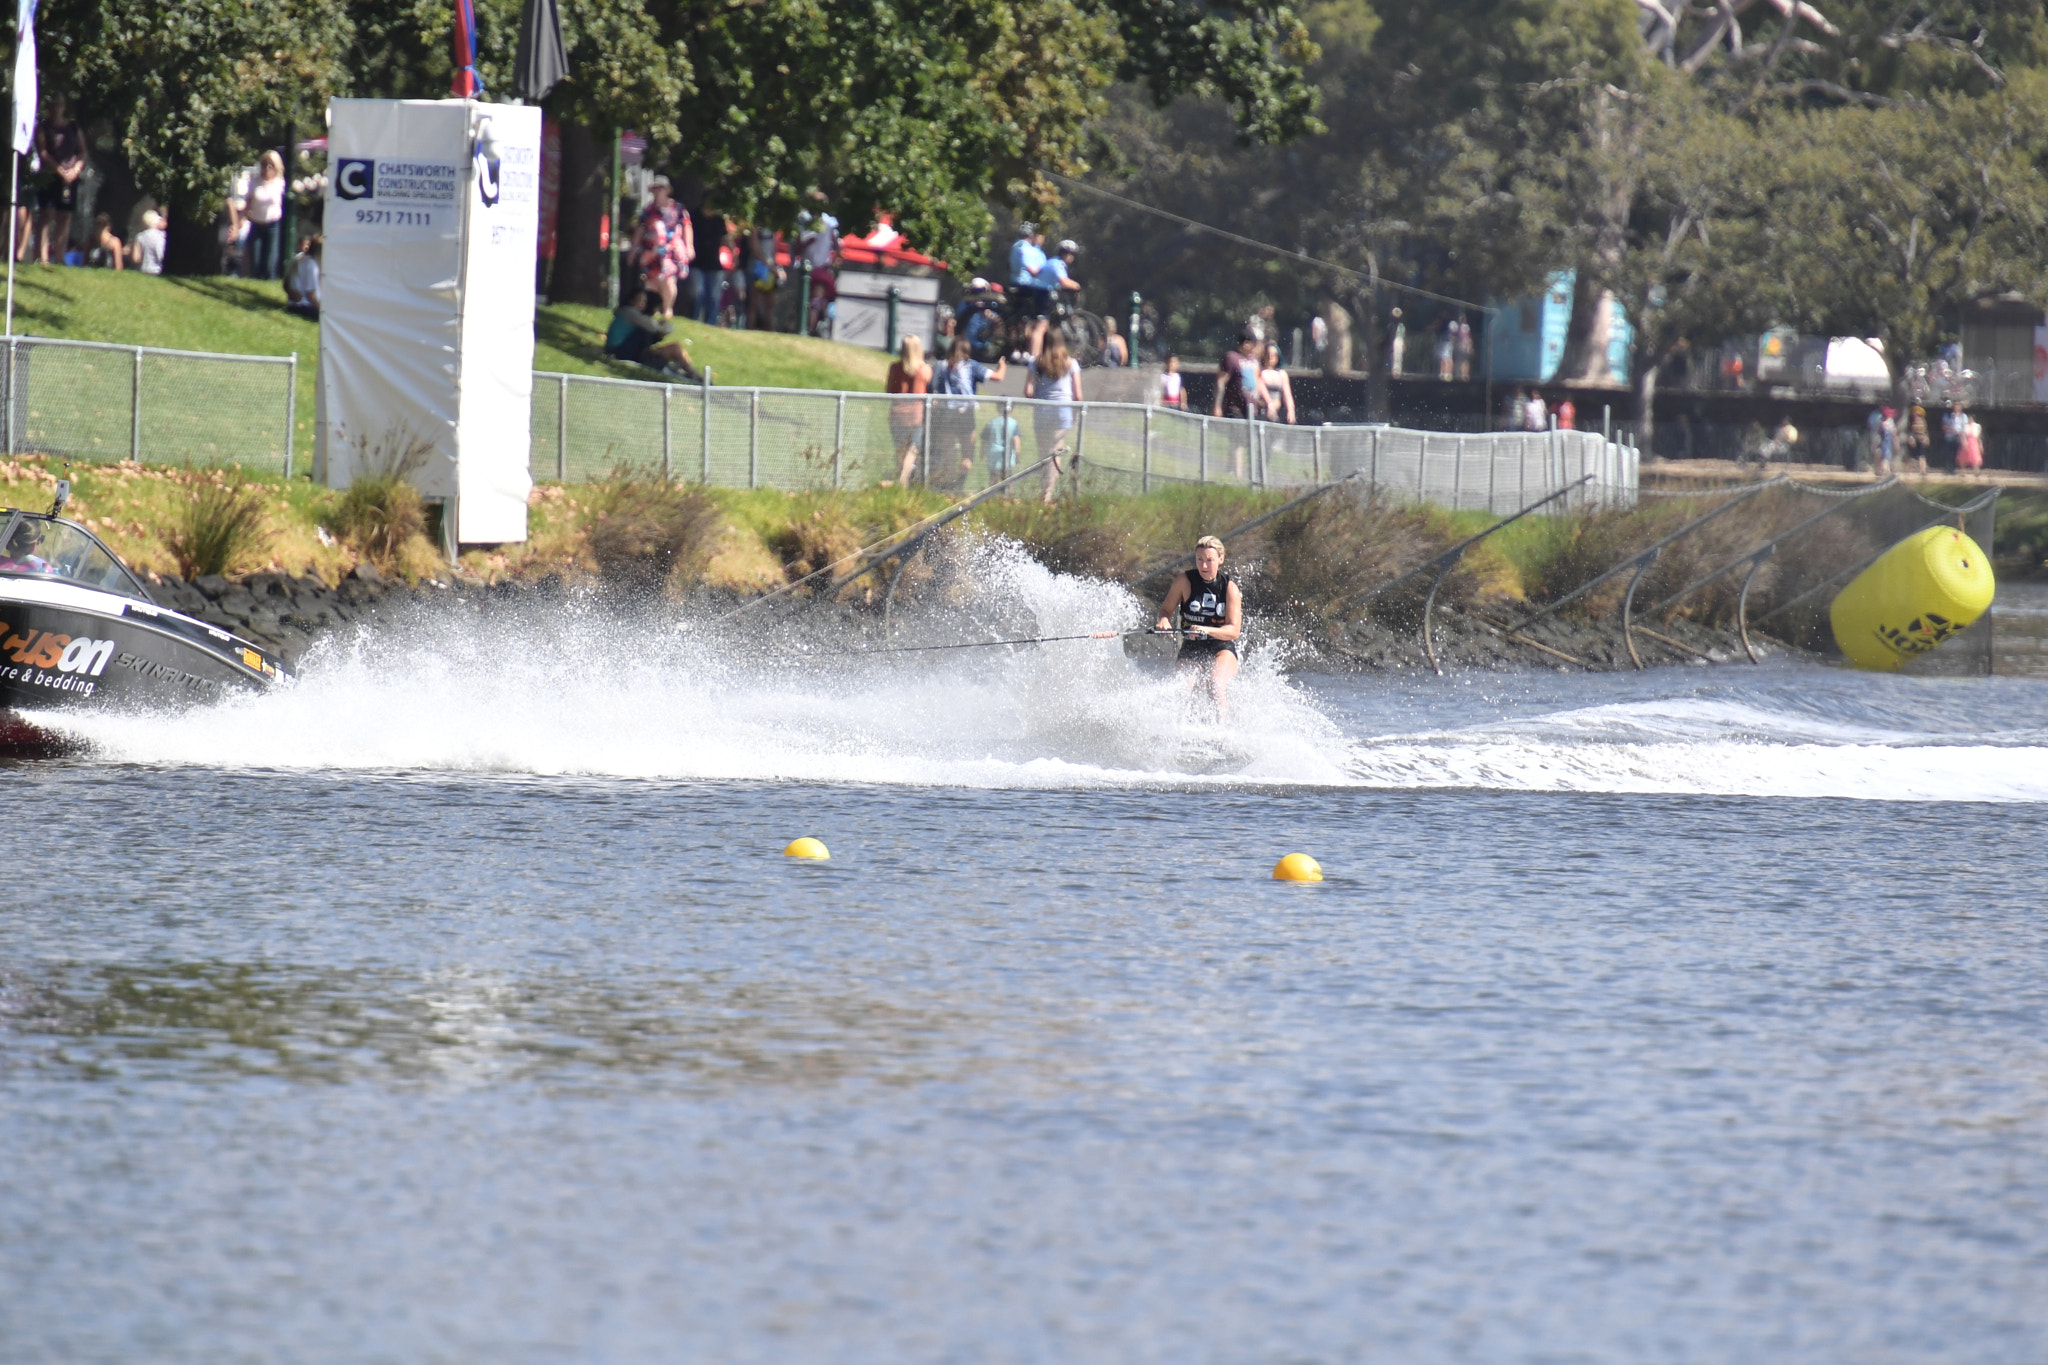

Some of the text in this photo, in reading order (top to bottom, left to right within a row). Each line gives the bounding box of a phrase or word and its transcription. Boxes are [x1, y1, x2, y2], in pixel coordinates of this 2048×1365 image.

[378, 163, 456, 177] CHATSWORTH
[377, 177, 455, 191] CONSTRUCTIONS
[356, 209, 431, 226] 9571 7111
[0, 665, 95, 697] re & bedding
